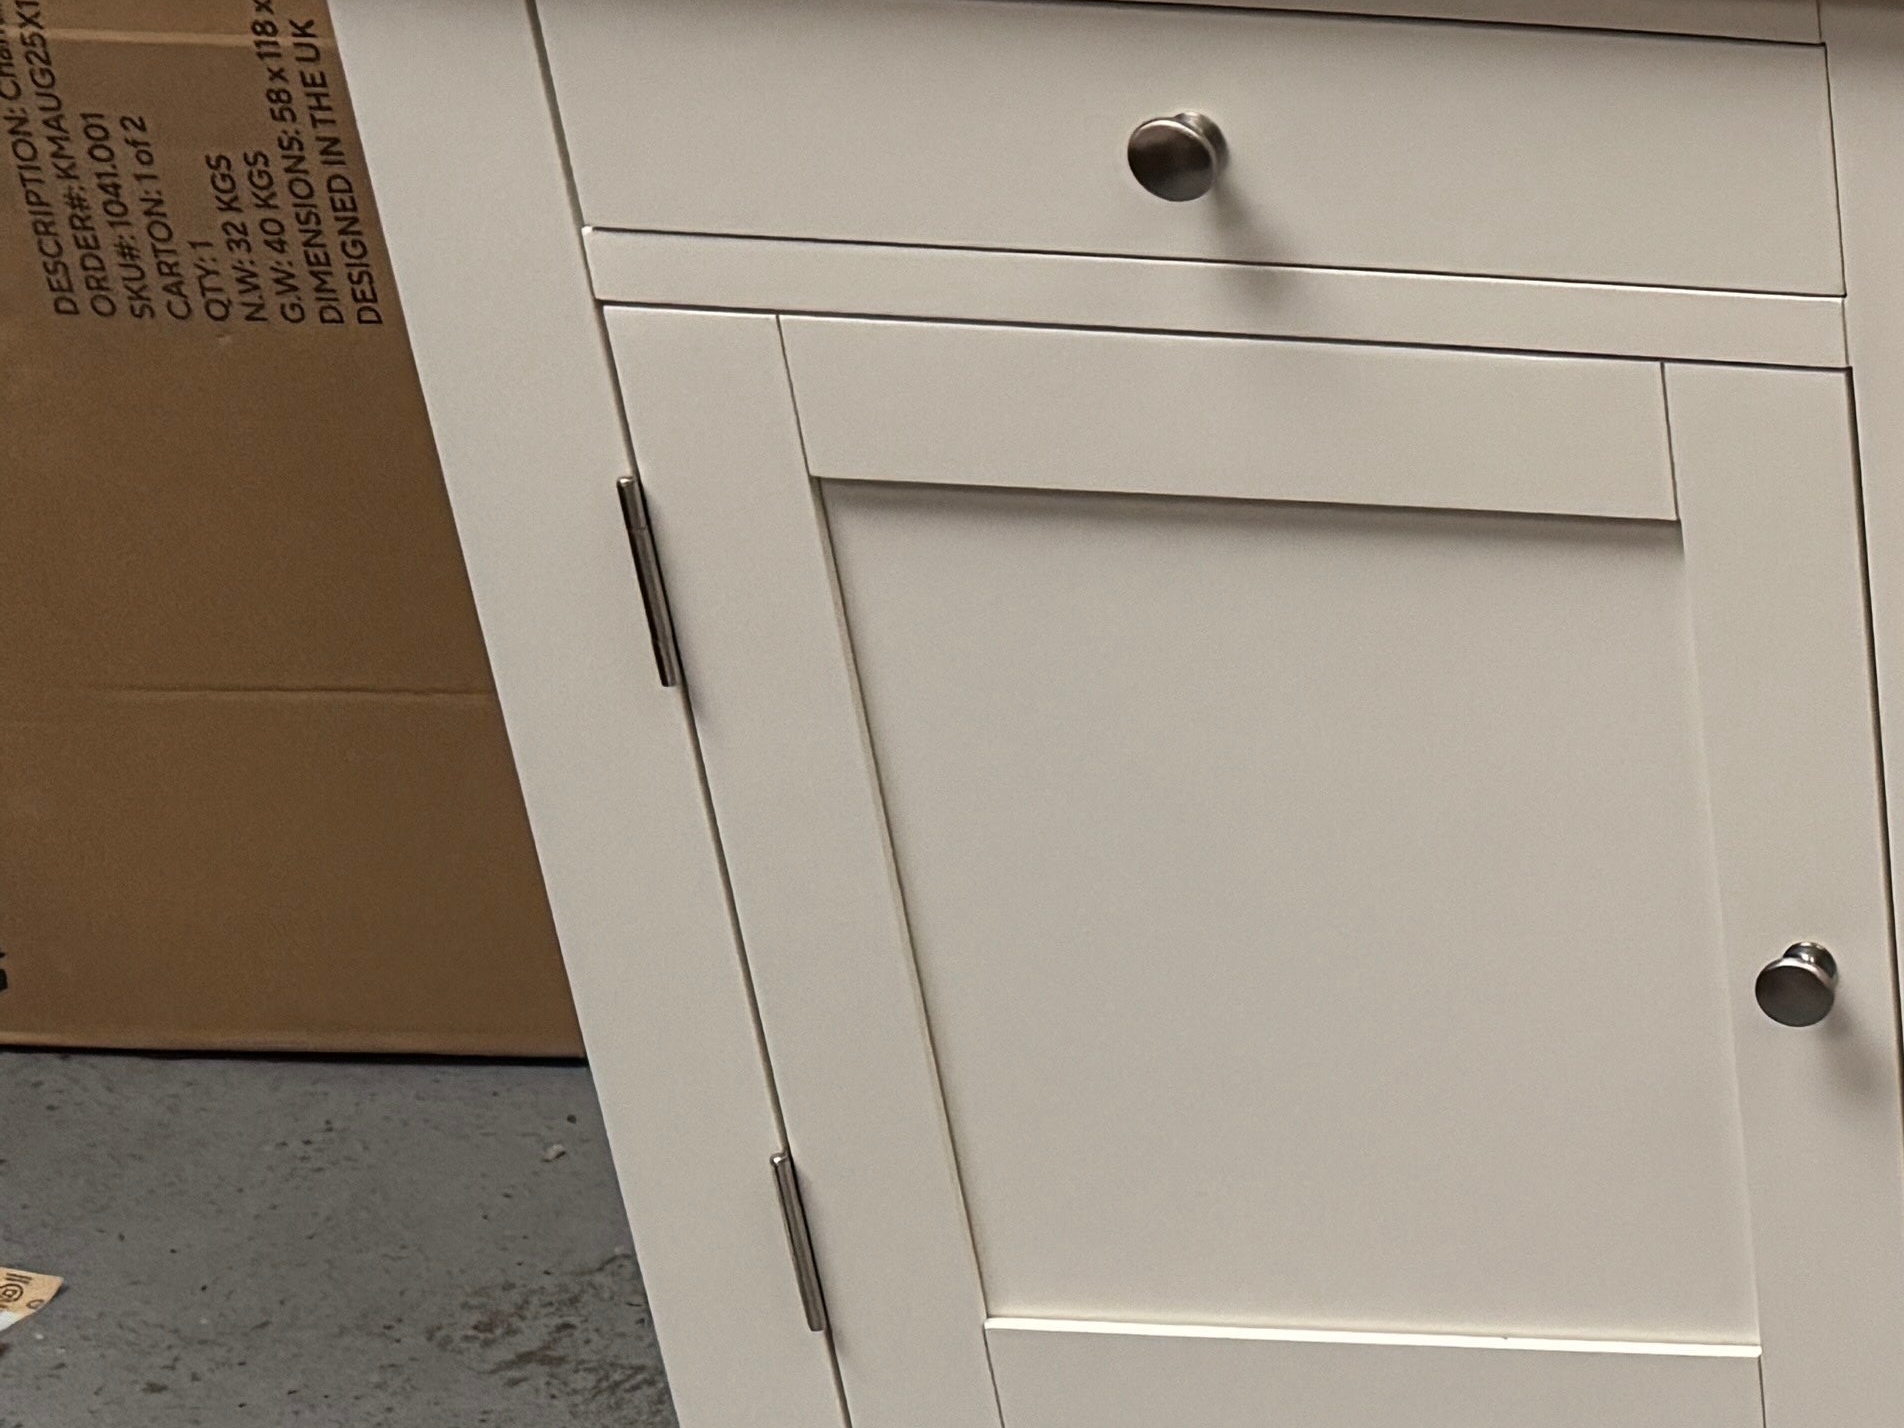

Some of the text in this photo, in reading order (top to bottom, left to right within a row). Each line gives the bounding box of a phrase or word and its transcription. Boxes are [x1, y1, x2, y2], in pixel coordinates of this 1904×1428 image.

[250, 19, 283, 61] 118
[264, 87, 298, 124] 58
[266, 66, 290, 84] x
[2, 107, 81, 316] DESCRIPTION:
[79, 112, 156, 320] SKU#: 1041.001
[118, 115, 193, 321] CARTON: 1 of 2
[204, 153, 269, 322] N.W: 32 KGS
[242, 150, 306, 325] G.W: 40 KGS
[276, 129, 345, 325] DIMENSIONS:
[287, 19, 384, 325] DESIGNED IN THE UK
[186, 240, 233, 322] QTY: 1
